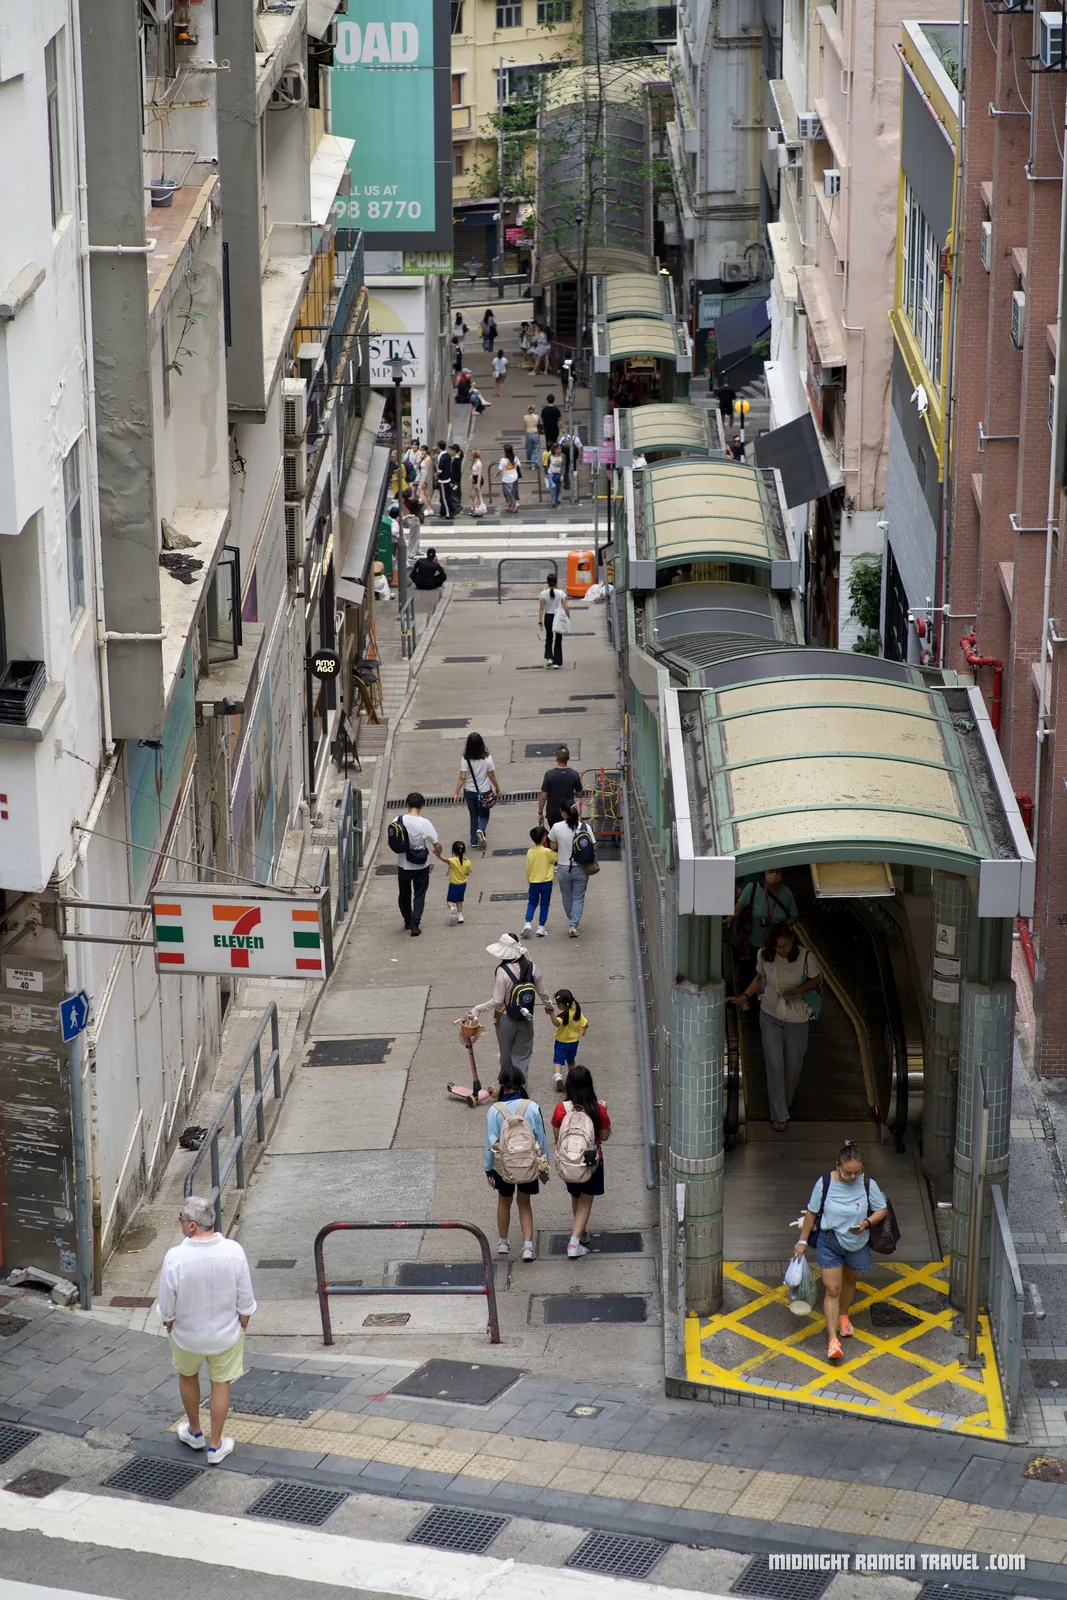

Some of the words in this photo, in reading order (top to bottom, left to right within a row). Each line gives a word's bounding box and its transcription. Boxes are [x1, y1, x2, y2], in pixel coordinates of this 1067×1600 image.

[364, 185, 380, 196] US
[383, 185, 398, 196] AT
[367, 201, 421, 218] 8770
[370, 368, 419, 377] MPNY
[212, 904, 261, 968] 7
[20, 981, 29, 989] 40
